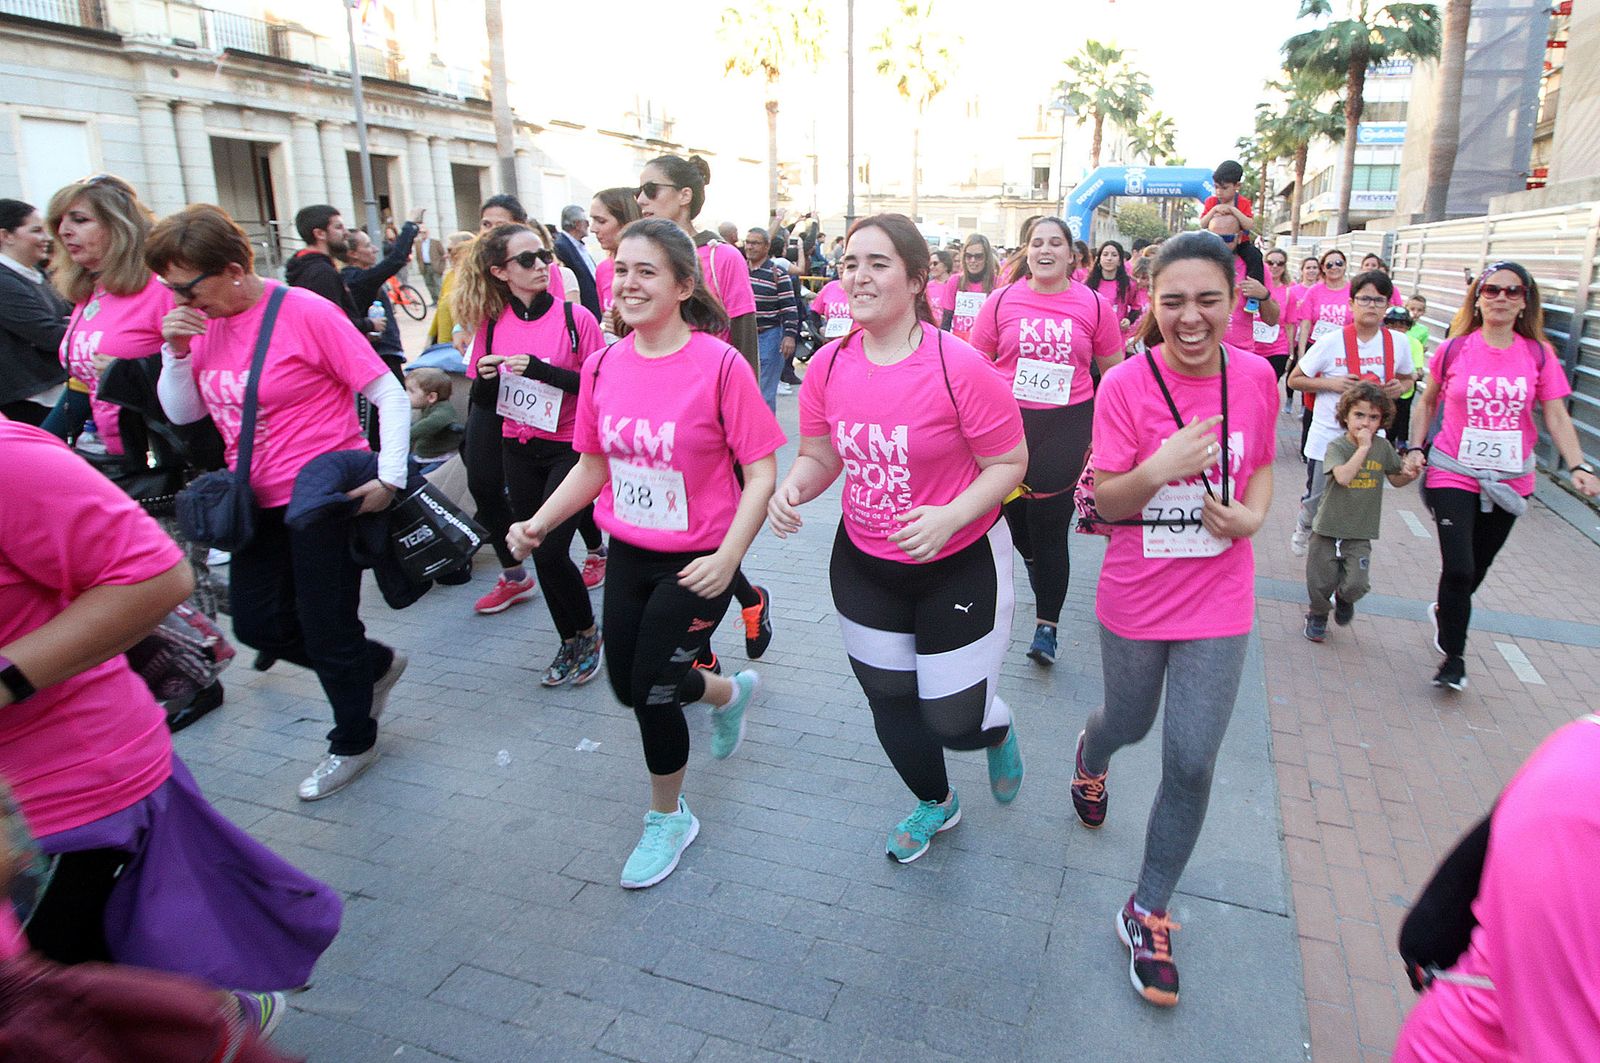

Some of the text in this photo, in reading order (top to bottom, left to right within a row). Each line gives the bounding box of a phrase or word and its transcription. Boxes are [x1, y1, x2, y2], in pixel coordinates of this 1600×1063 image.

[1146, 187, 1182, 195] HUELVA
[1319, 304, 1347, 317] KM
[1019, 318, 1072, 343] KM
[1019, 341, 1072, 364] POR
[1016, 369, 1051, 390] 546
[1466, 375, 1528, 401] KM
[504, 385, 537, 410] 109
[1466, 398, 1525, 417] POR
[1467, 415, 1520, 430] ELLAS
[601, 415, 676, 462] KM
[836, 420, 908, 465] KM
[1462, 439, 1503, 458] 125
[842, 458, 911, 492] POR
[848, 483, 913, 513] ELLAS
